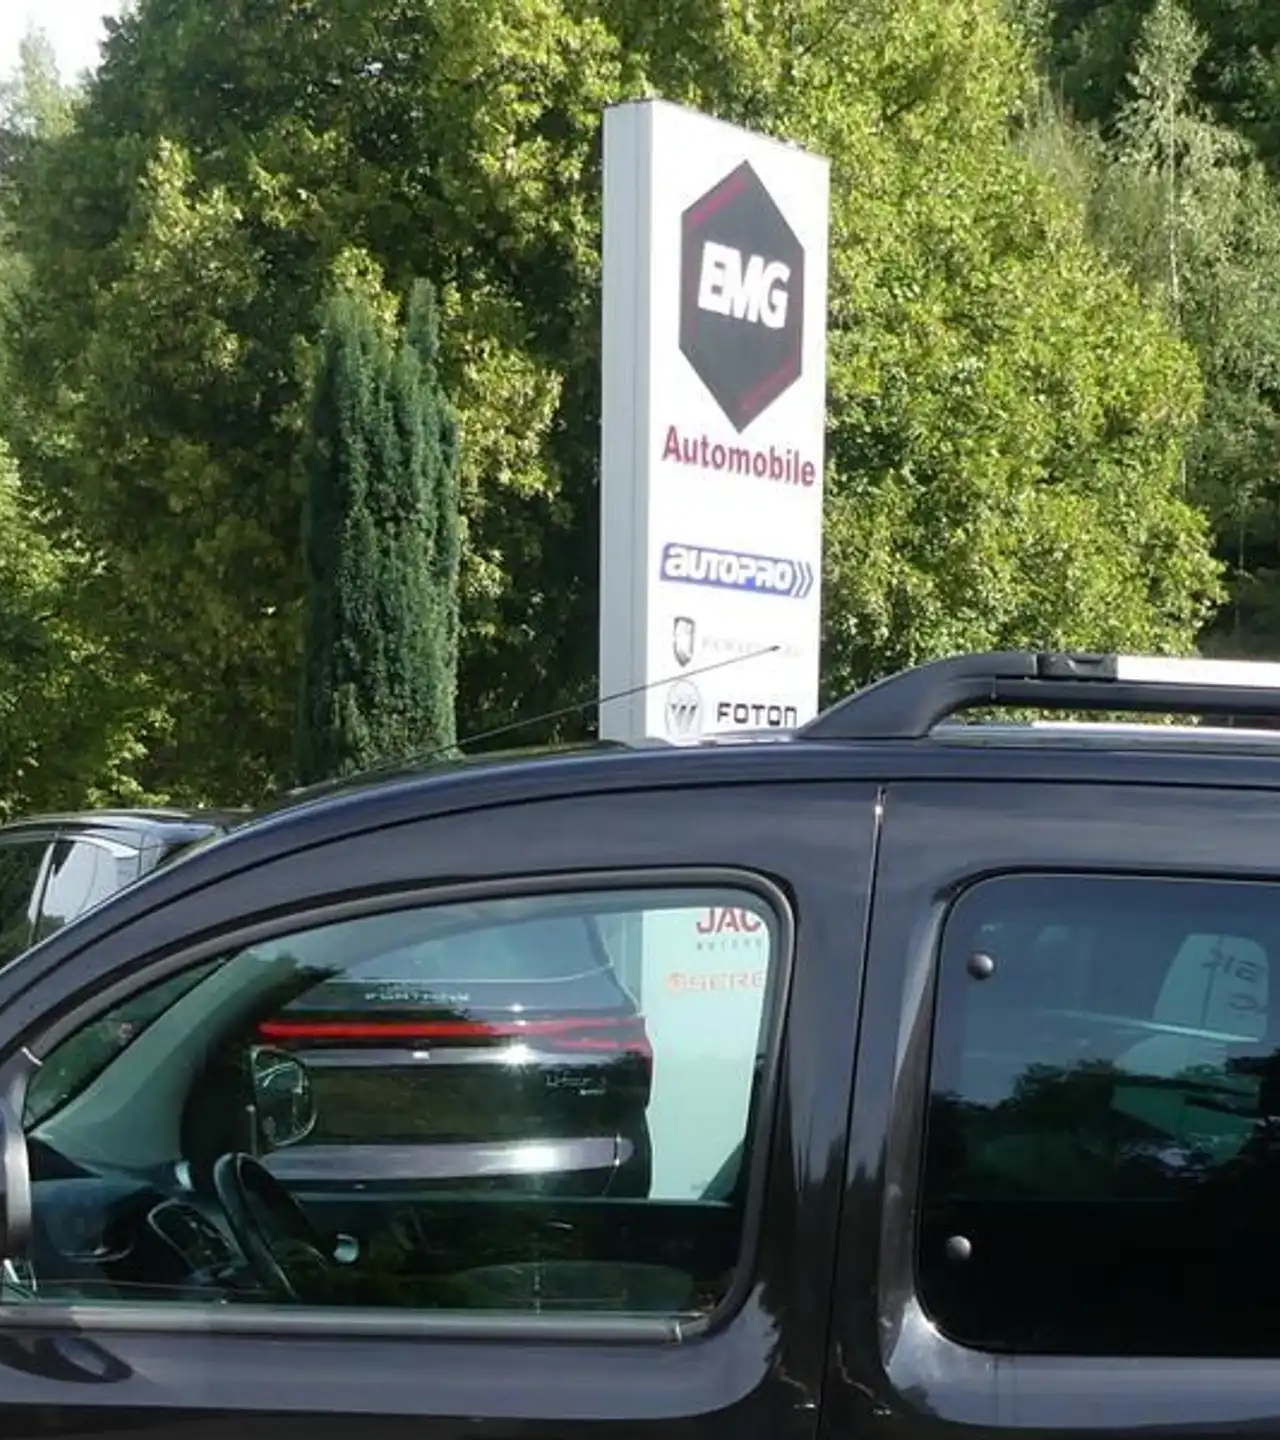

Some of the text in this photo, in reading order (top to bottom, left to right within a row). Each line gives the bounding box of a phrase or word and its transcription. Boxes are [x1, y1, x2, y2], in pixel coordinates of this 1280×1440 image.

[698, 240, 791, 328] EMG
[661, 424, 817, 487] Automobile
[716, 702, 798, 727] FOTON
[695, 907, 762, 934] JAC
